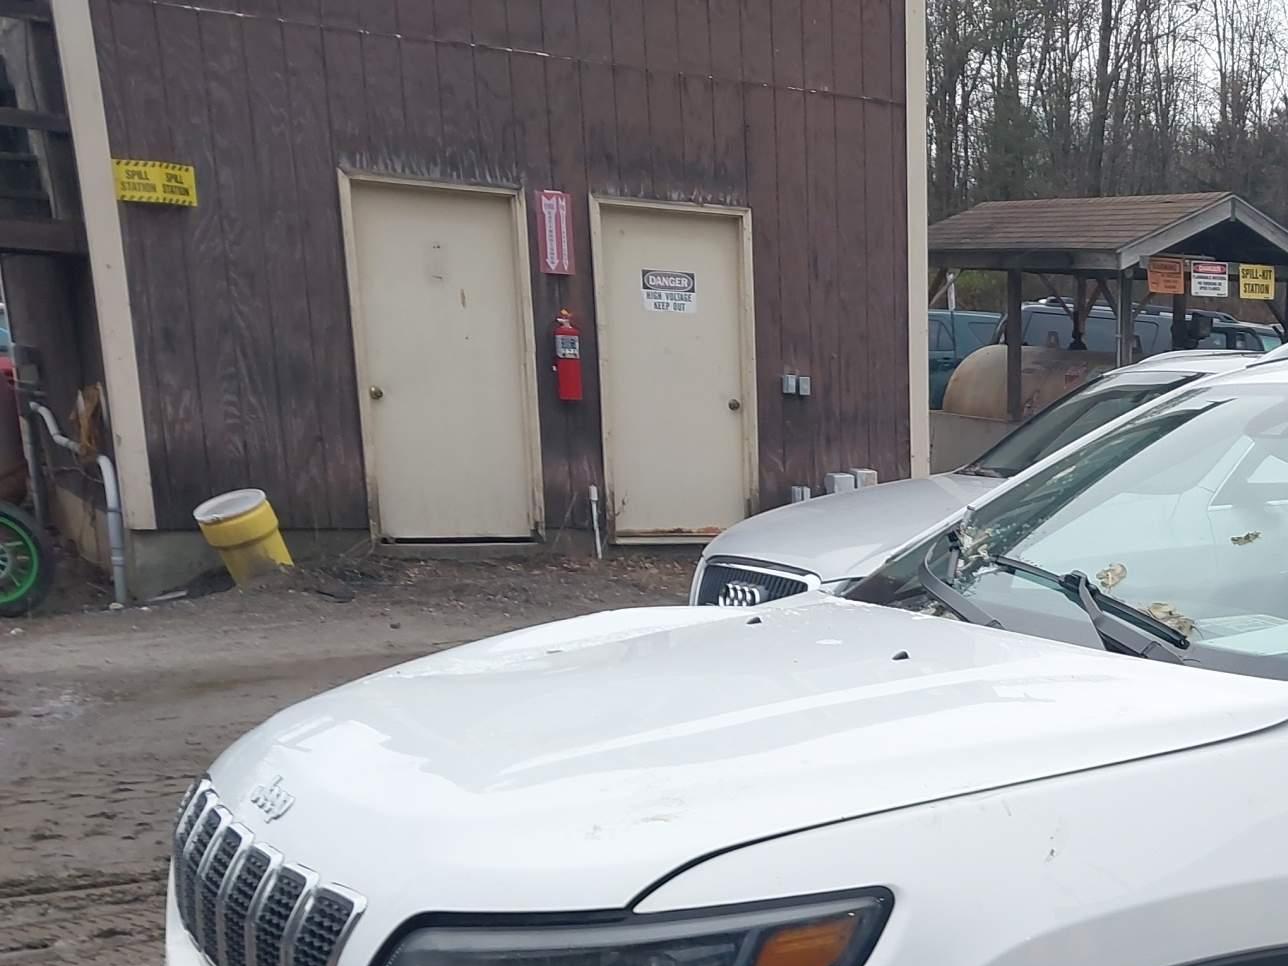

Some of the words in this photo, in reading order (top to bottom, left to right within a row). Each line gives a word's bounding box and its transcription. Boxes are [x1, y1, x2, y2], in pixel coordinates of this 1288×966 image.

[126, 169, 150, 181] SPILL
[166, 172, 184, 185] SPILL
[120, 180, 157, 193] STATION
[162, 183, 190, 197] STATION
[1241, 268, 1273, 280] SPILL-KIT
[649, 275, 689, 288] DANGER
[1243, 283, 1270, 294] STATION
[646, 291, 662, 300] HIGH
[665, 292, 693, 302] VOLTAGE
[654, 301, 670, 310] KEEP
[672, 302, 686, 311] OUT
